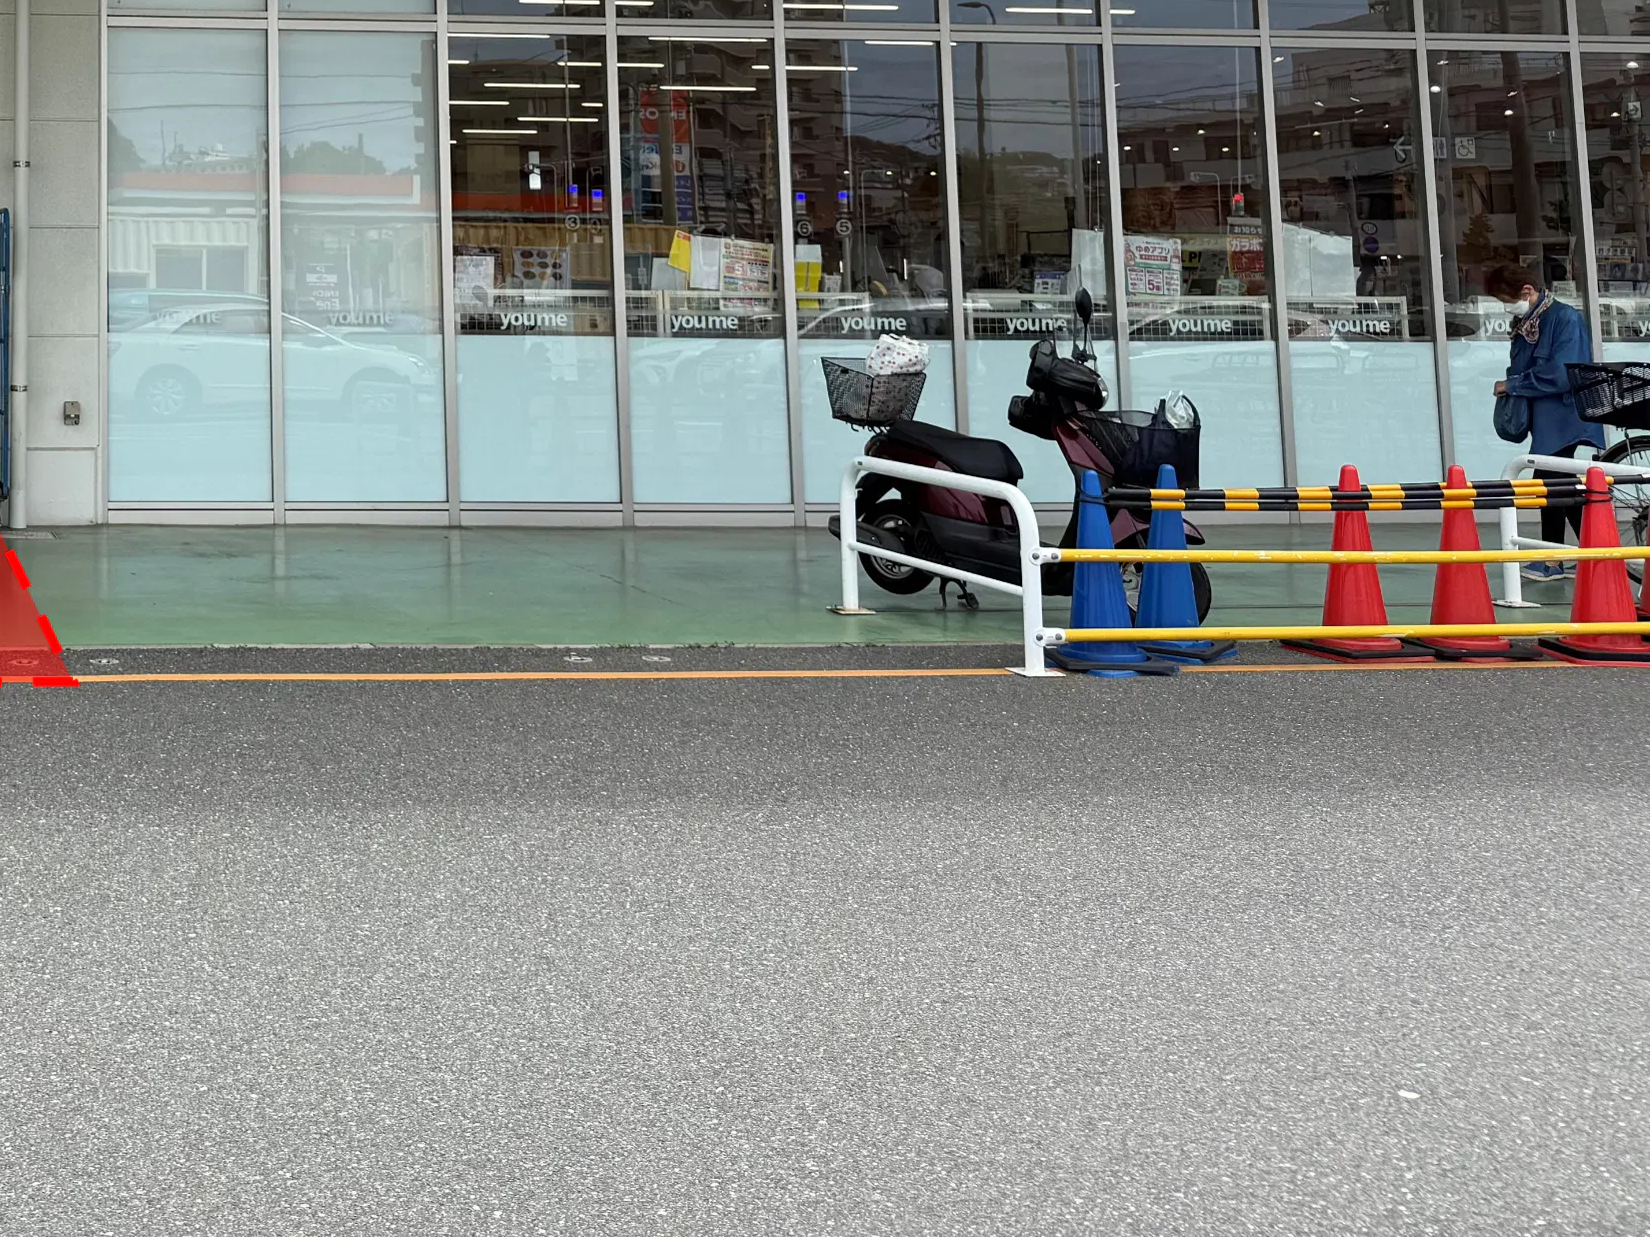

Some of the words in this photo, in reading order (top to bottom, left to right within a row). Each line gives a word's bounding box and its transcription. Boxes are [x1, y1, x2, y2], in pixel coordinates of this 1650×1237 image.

[500, 312, 567, 330] youme
[671, 314, 738, 332] youme
[840, 316, 907, 333] youme
[1169, 318, 1232, 336] youme
[1328, 319, 1391, 336] youme
